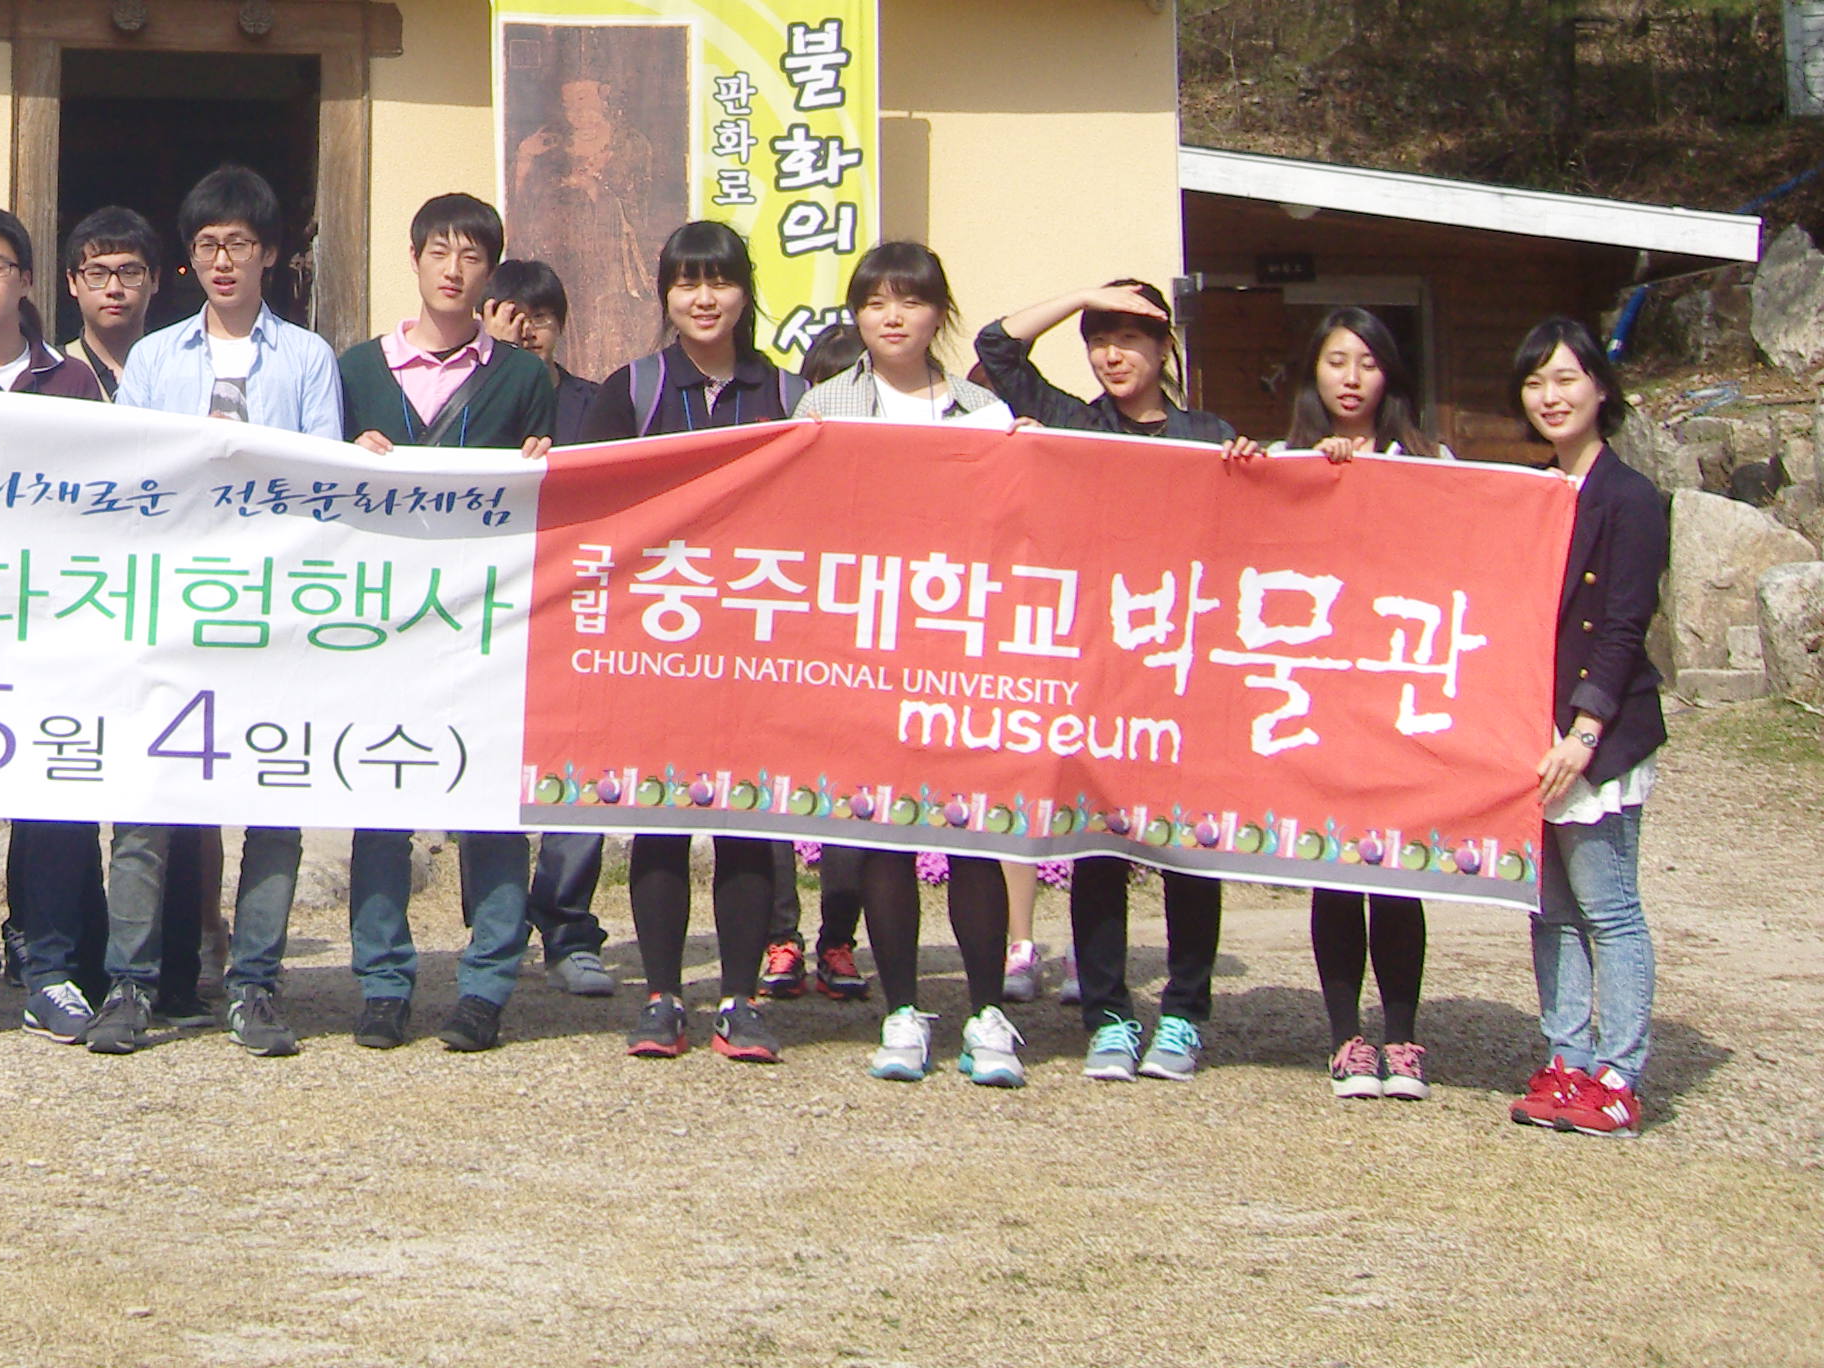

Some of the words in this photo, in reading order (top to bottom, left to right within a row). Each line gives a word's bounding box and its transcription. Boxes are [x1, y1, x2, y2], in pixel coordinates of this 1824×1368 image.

[712, 71, 758, 206] 판화로
[771, 18, 863, 258] 불화의
[211, 478, 512, 528] 전통문화체험
[572, 543, 615, 634] 국립
[571, 648, 726, 682] CHUNGJU
[732, 653, 894, 692] NATIONAL
[901, 668, 1080, 706] UNIVERSITY
[628, 539, 1082, 660] 충주대학교
[1110, 560, 1487, 756] 박물관
[145, 689, 467, 794] 4일(수)
[897, 698, 1182, 763] museum
